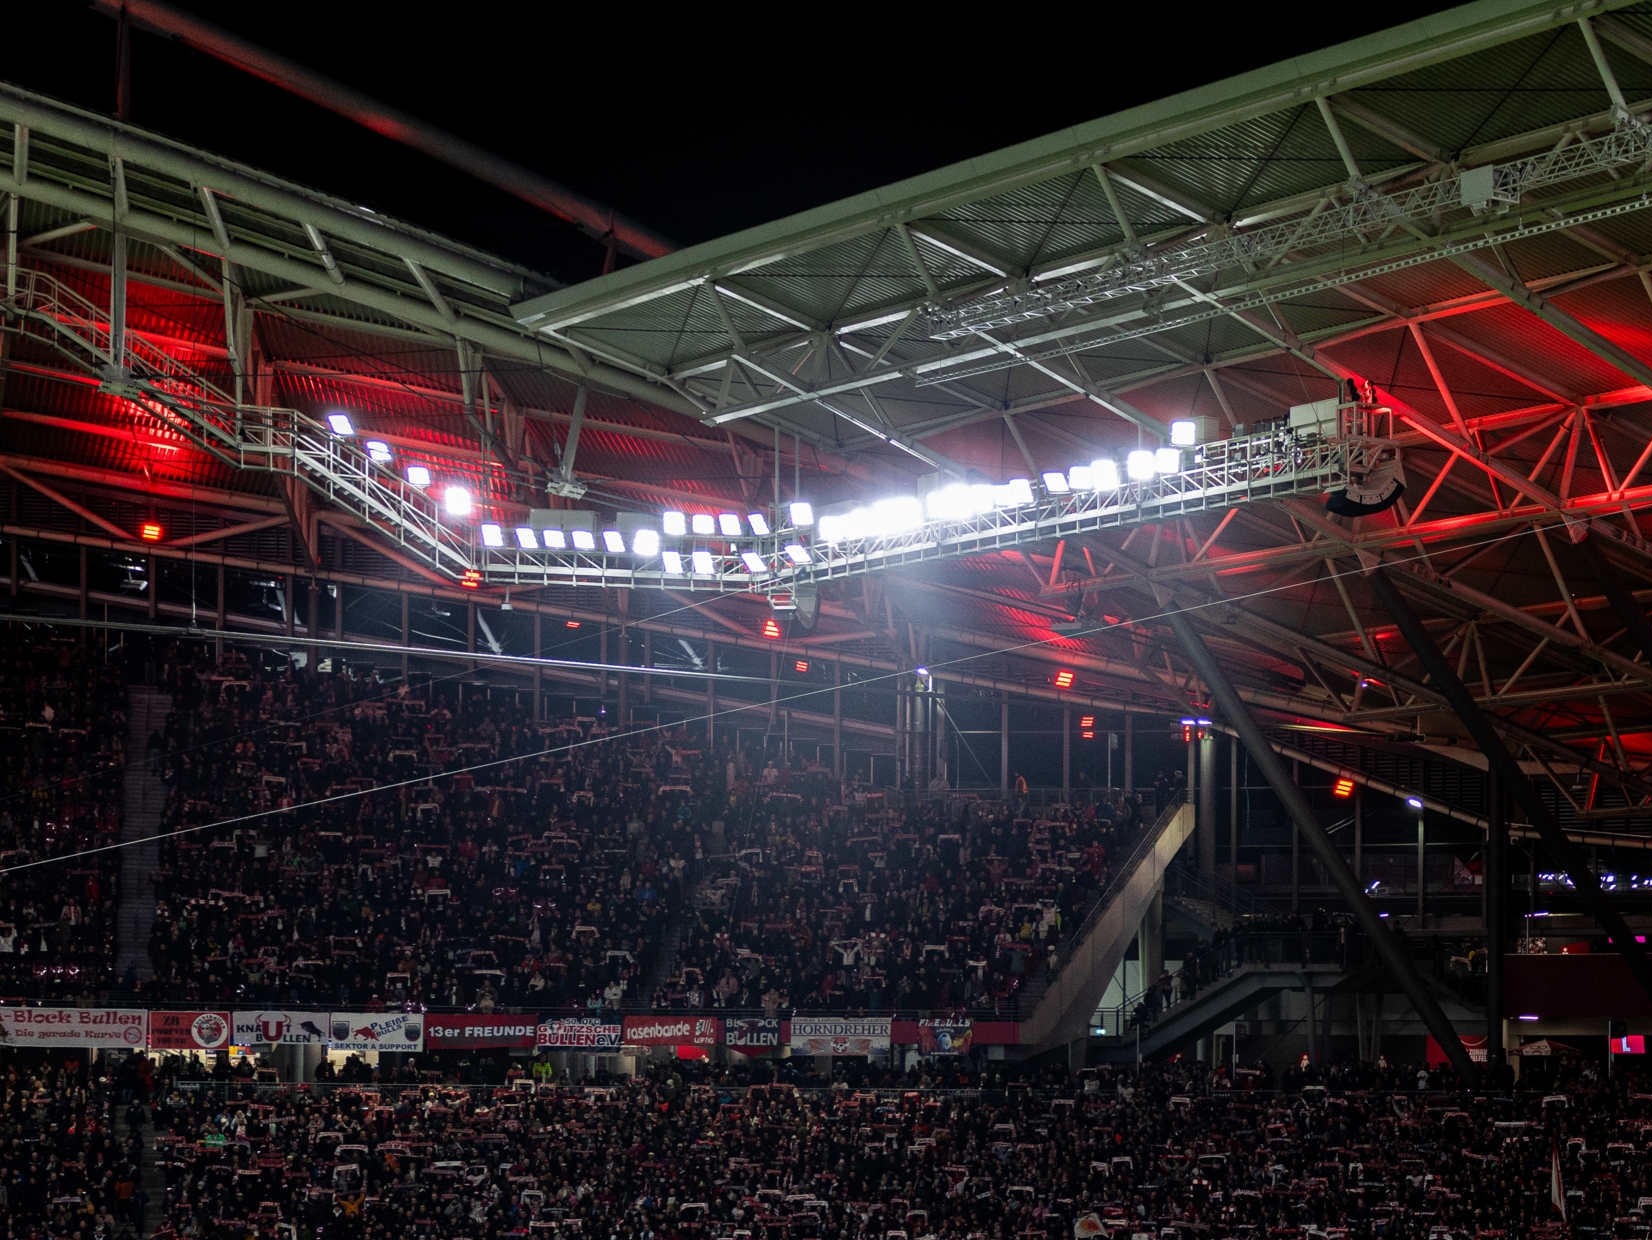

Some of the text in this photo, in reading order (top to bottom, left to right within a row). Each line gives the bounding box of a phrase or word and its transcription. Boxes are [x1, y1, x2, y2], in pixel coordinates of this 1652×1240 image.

[0, 1009, 142, 1026] -Block Bullen
[15, 1029, 34, 1038] Die
[84, 1029, 121, 1039] Kurve
[428, 1025, 535, 1037] 13er FREUNDE
[791, 1022, 889, 1036] HORNDREHER
[537, 1033, 596, 1046] BULLEN
[726, 1032, 778, 1046] BULLEN
